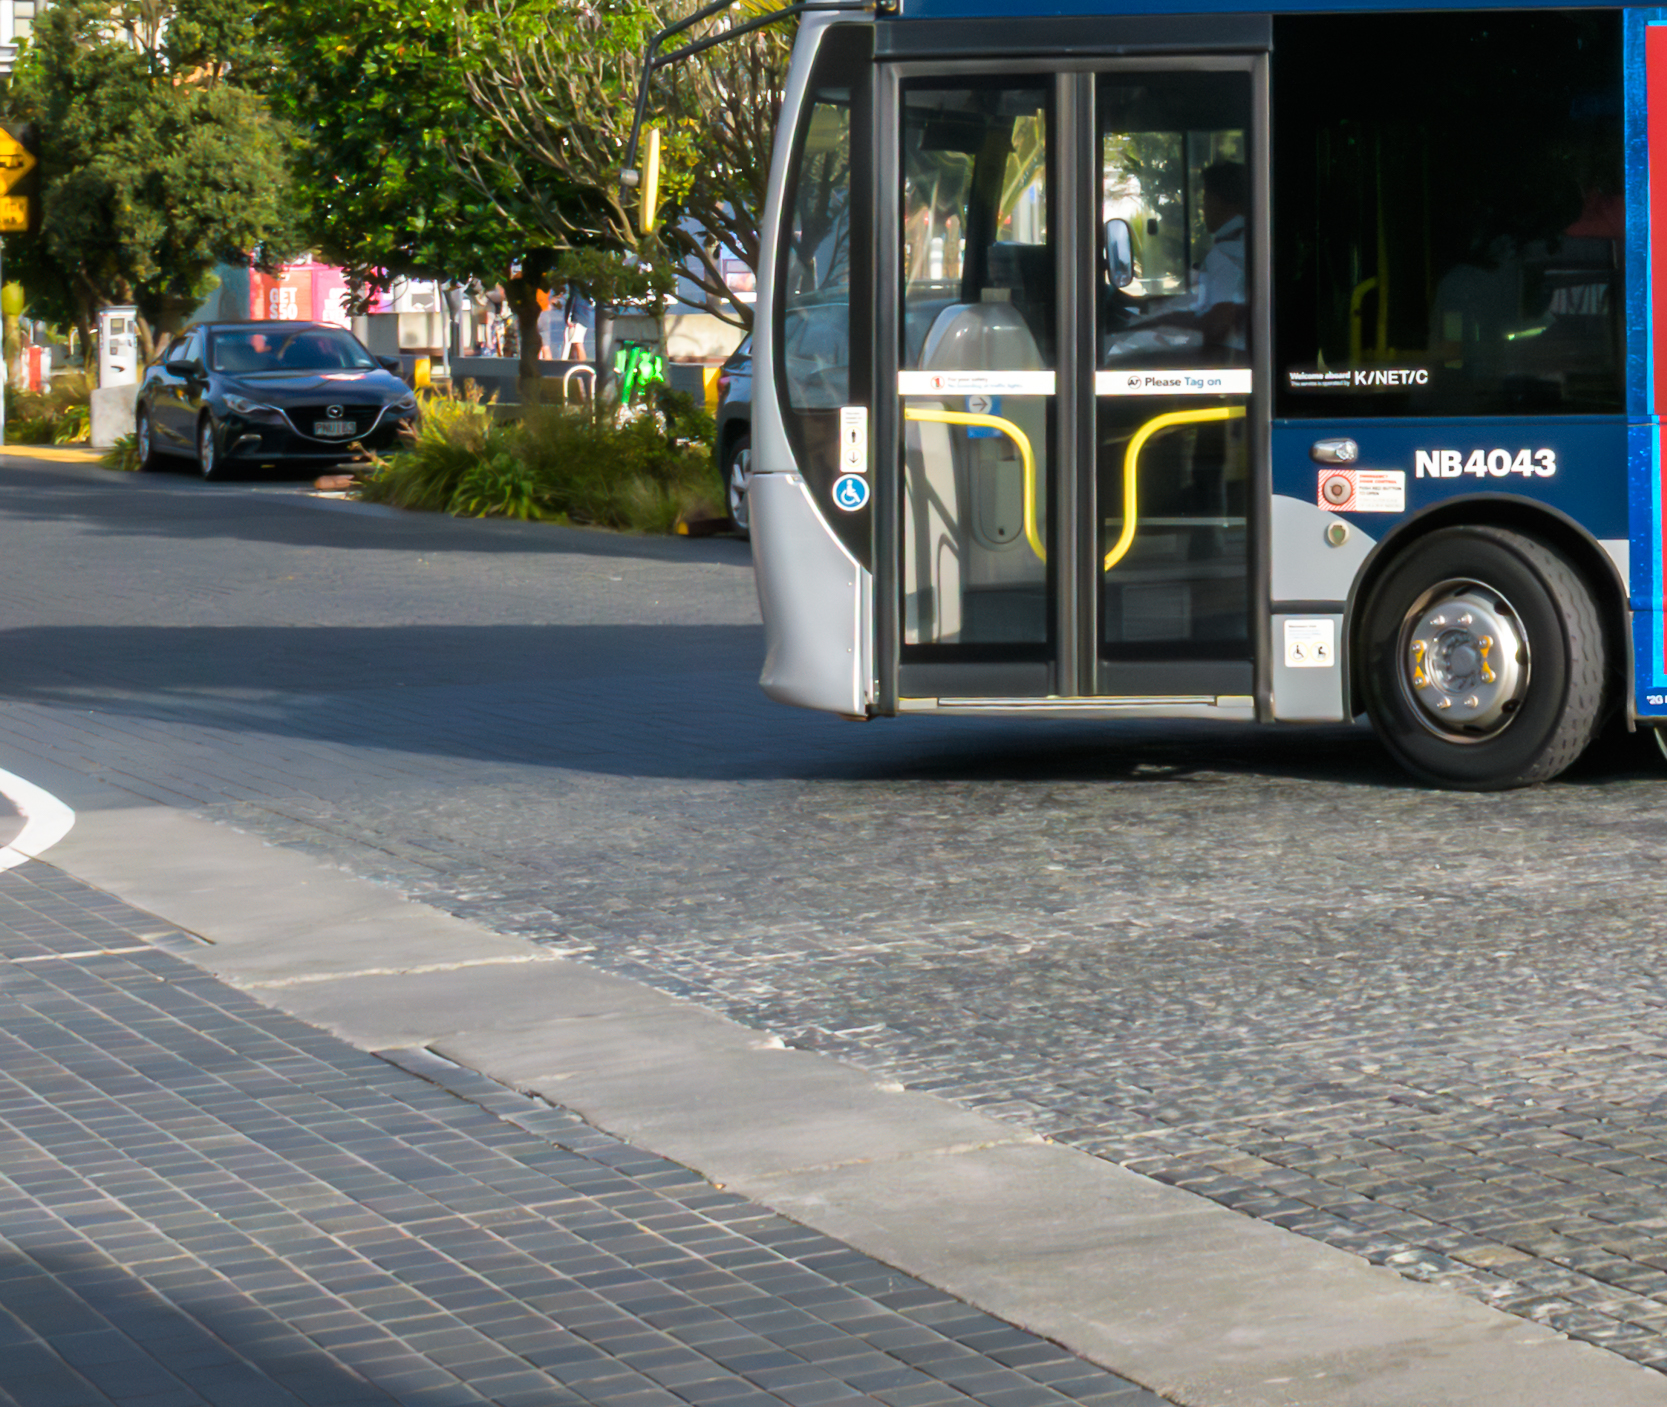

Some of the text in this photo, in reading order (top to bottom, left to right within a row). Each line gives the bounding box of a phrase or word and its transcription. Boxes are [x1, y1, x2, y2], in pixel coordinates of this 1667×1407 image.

[269, 287, 298, 304] GET
[1290, 370, 1351, 380] Welcome aboard
[1145, 377, 1181, 386] Please
[1184, 377, 1204, 389] Tag
[1207, 378, 1222, 386] on
[1416, 449, 1556, 478] NB4043
